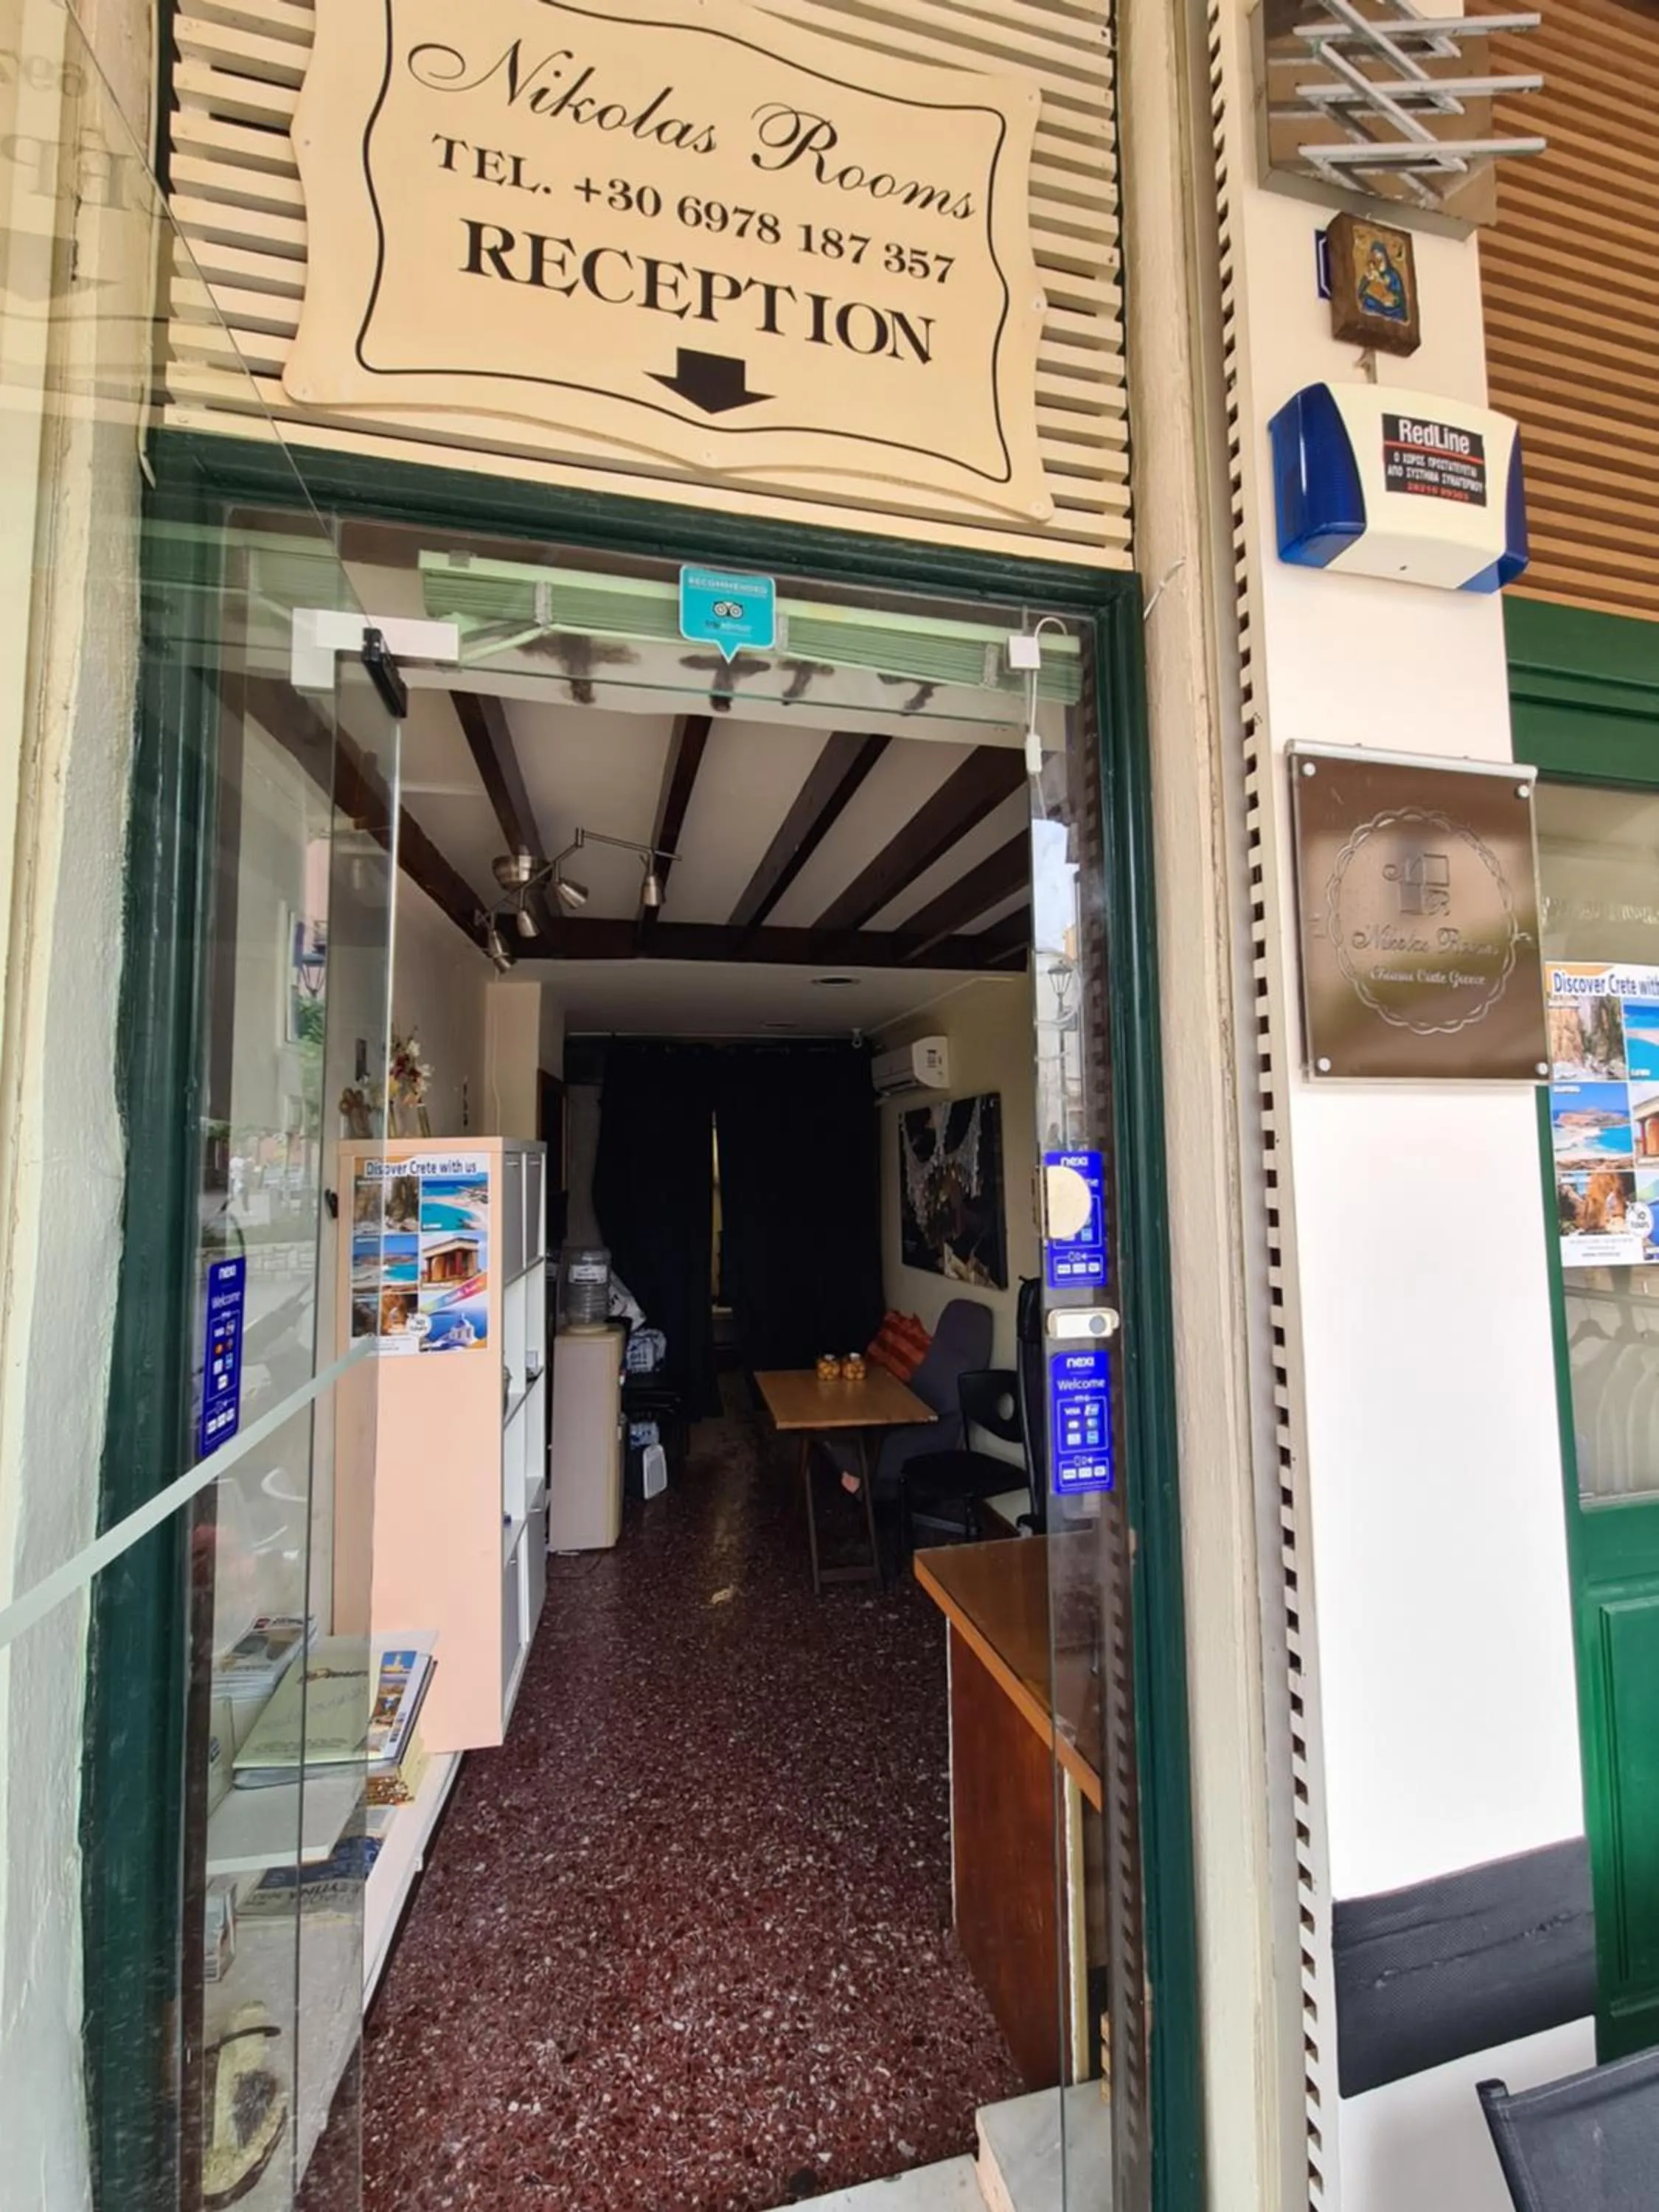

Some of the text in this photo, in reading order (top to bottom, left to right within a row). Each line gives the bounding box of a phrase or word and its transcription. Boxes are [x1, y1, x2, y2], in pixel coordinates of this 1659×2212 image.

[407, 38, 975, 220] Nikolas Rooms
[431, 133, 956, 285] TEL. +30 6978 187 357
[459, 218, 936, 366] RECEPTION
[1399, 419, 1470, 454] RedLine
[1554, 973, 1606, 994] Discover
[1608, 974, 1636, 995] Crete
[409, 1160, 437, 1175] Crete
[439, 1160, 463, 1173] with
[465, 1161, 477, 1173] us
[1057, 1377, 1106, 1391] Welcome
